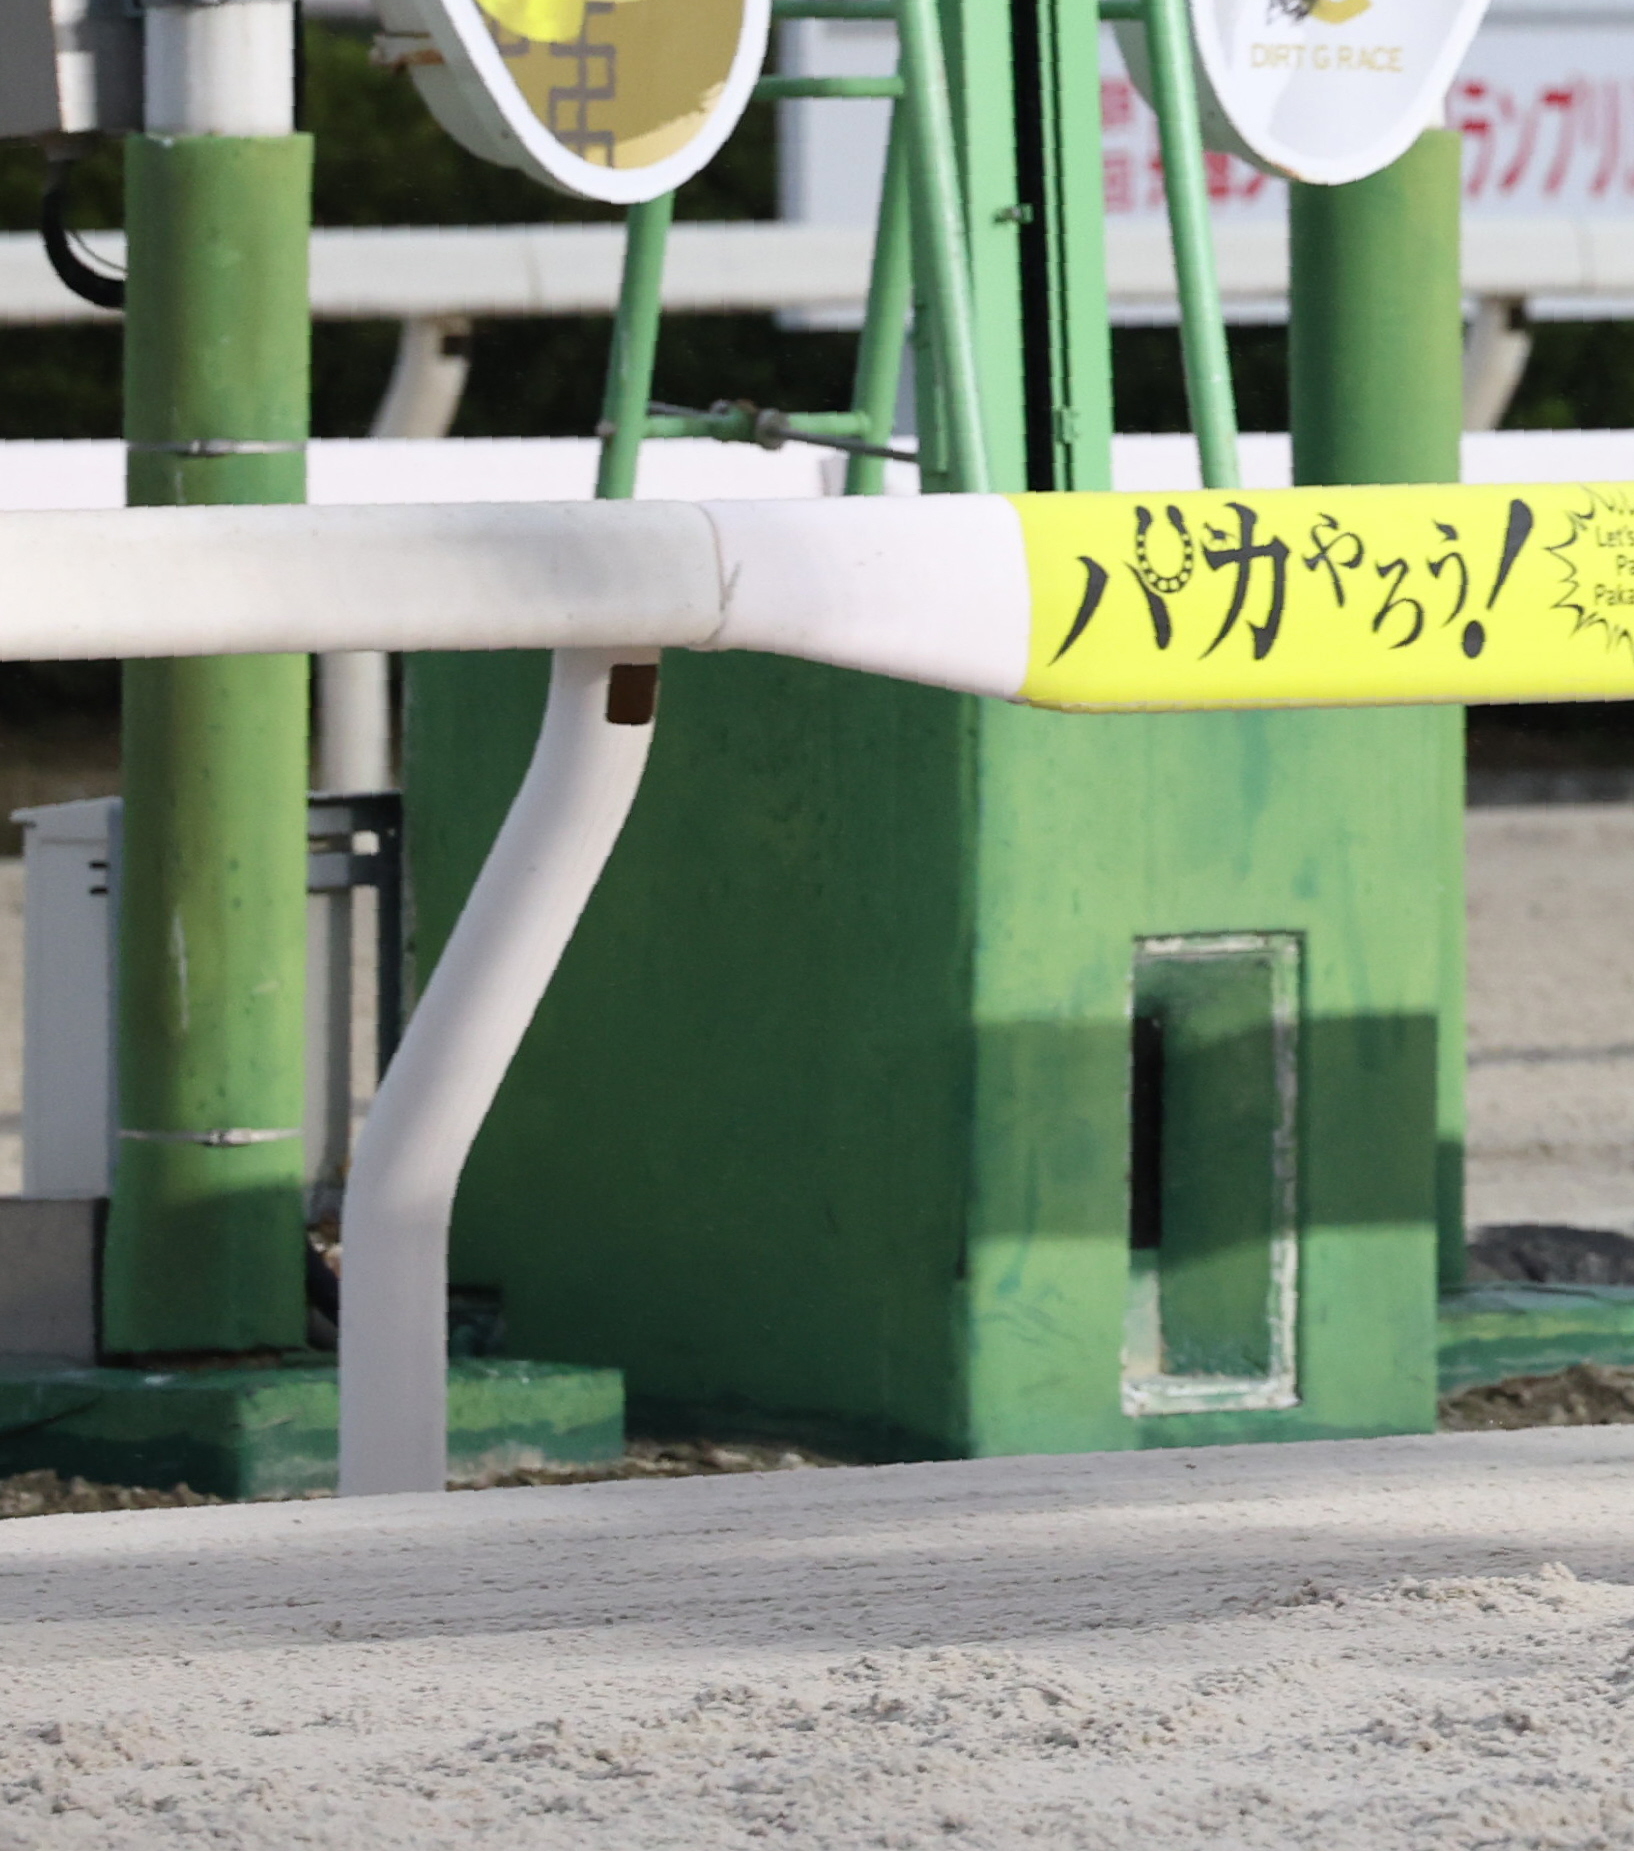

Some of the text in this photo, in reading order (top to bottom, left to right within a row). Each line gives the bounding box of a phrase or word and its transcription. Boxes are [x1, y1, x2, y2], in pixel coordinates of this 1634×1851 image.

[1250, 42, 1403, 73] DIRT G RACE
